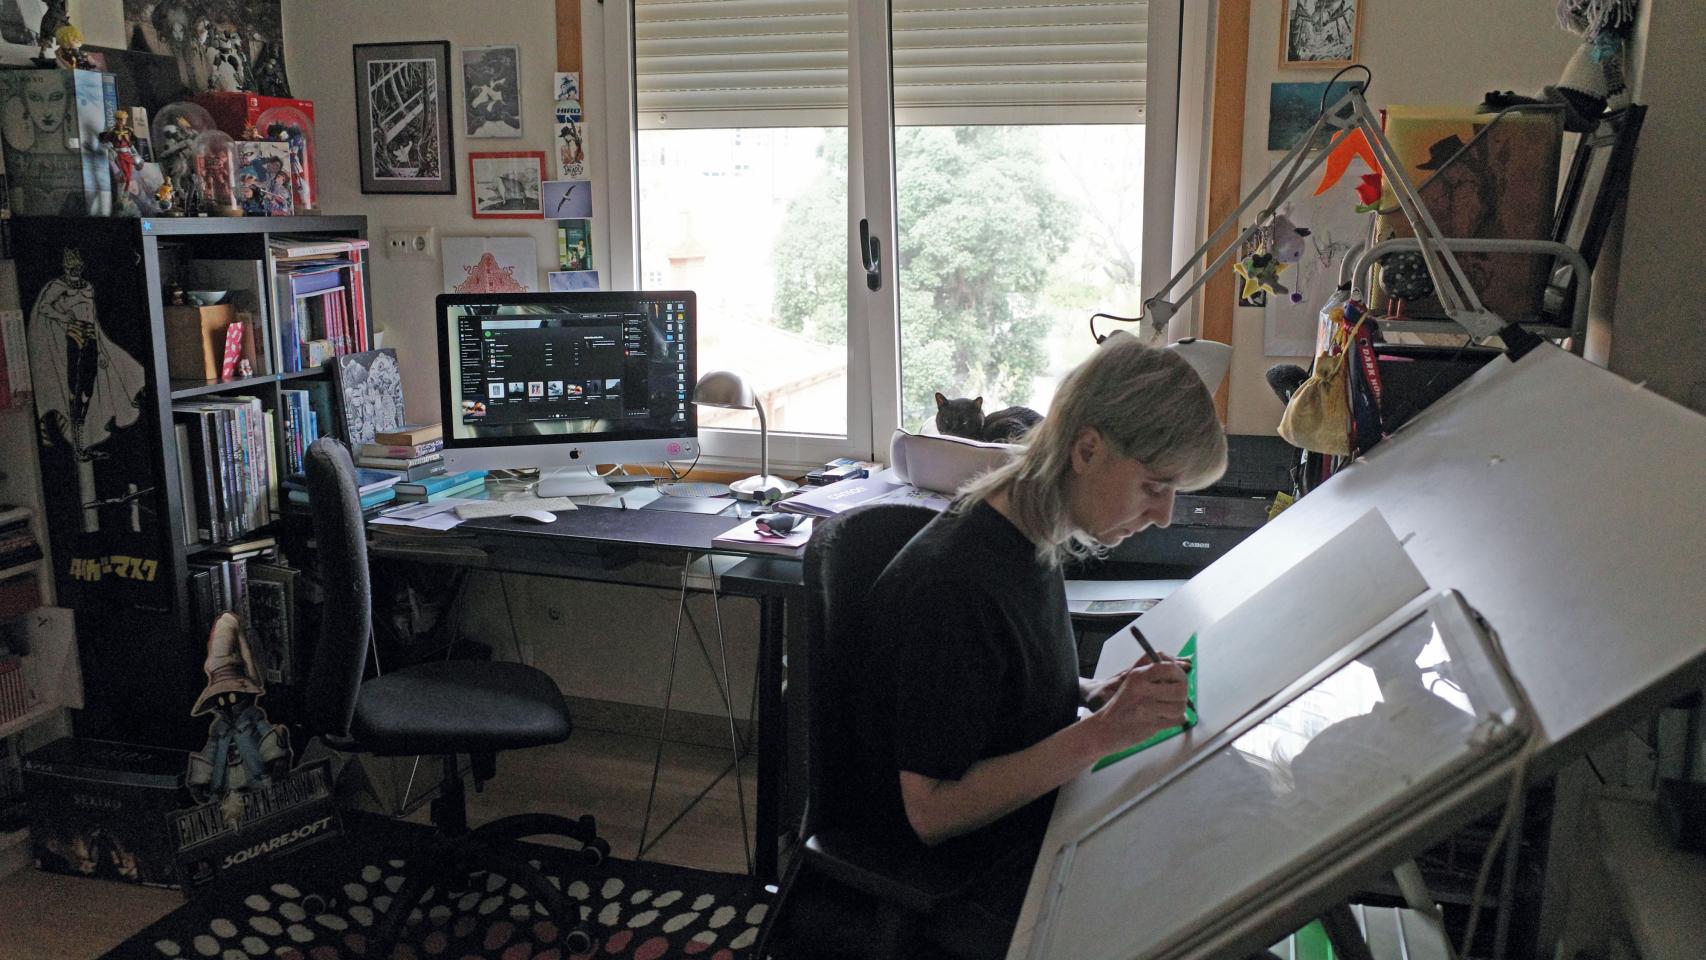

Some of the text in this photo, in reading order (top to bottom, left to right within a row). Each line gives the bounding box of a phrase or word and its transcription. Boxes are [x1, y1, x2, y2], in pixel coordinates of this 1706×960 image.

[1362, 348, 1376, 375] DARK
[241, 772, 309, 822] FANTASY
[221, 817, 331, 869] SQUARESOFT
